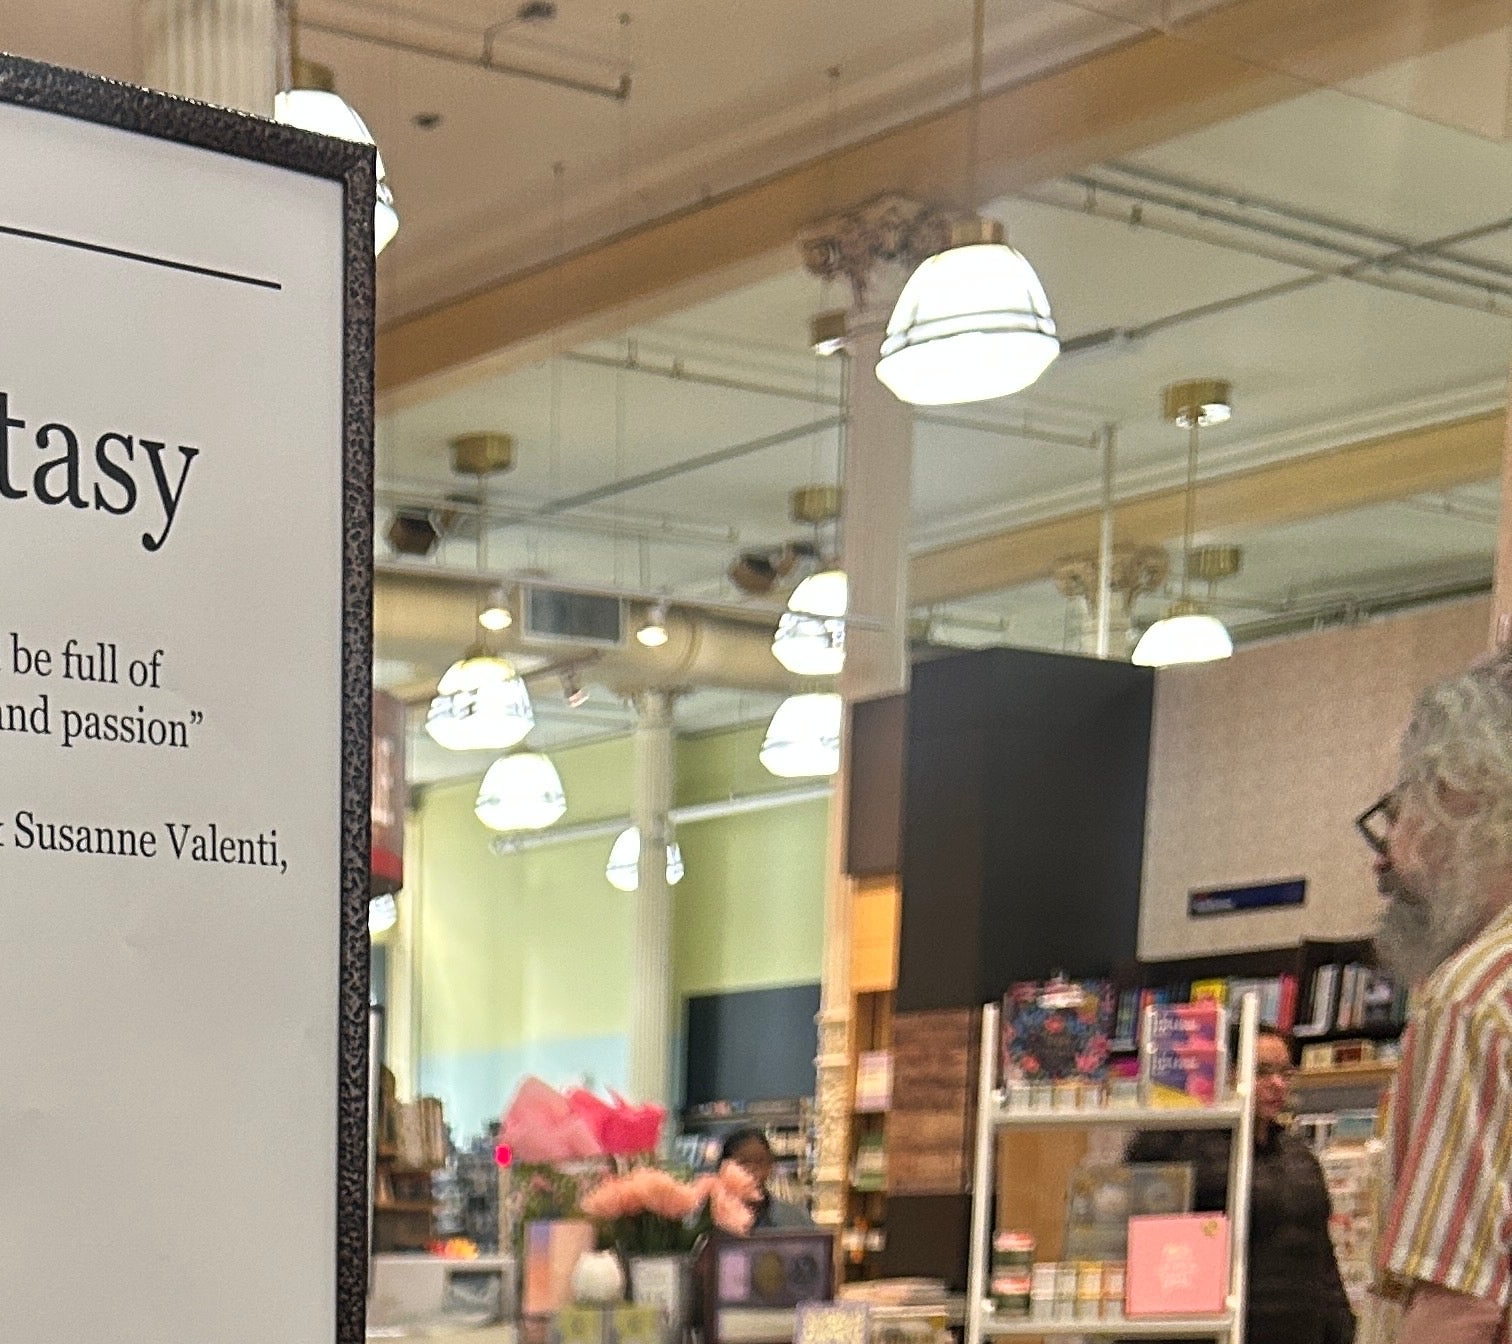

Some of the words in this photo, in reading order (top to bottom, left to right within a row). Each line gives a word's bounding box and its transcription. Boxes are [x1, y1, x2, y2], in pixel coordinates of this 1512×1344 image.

[11, 632, 52, 676] be
[62, 639, 118, 684] full
[129, 650, 164, 688] of
[61, 705, 204, 748] passion”
[14, 810, 157, 858] Susanne
[165, 822, 288, 875] Valenti,
